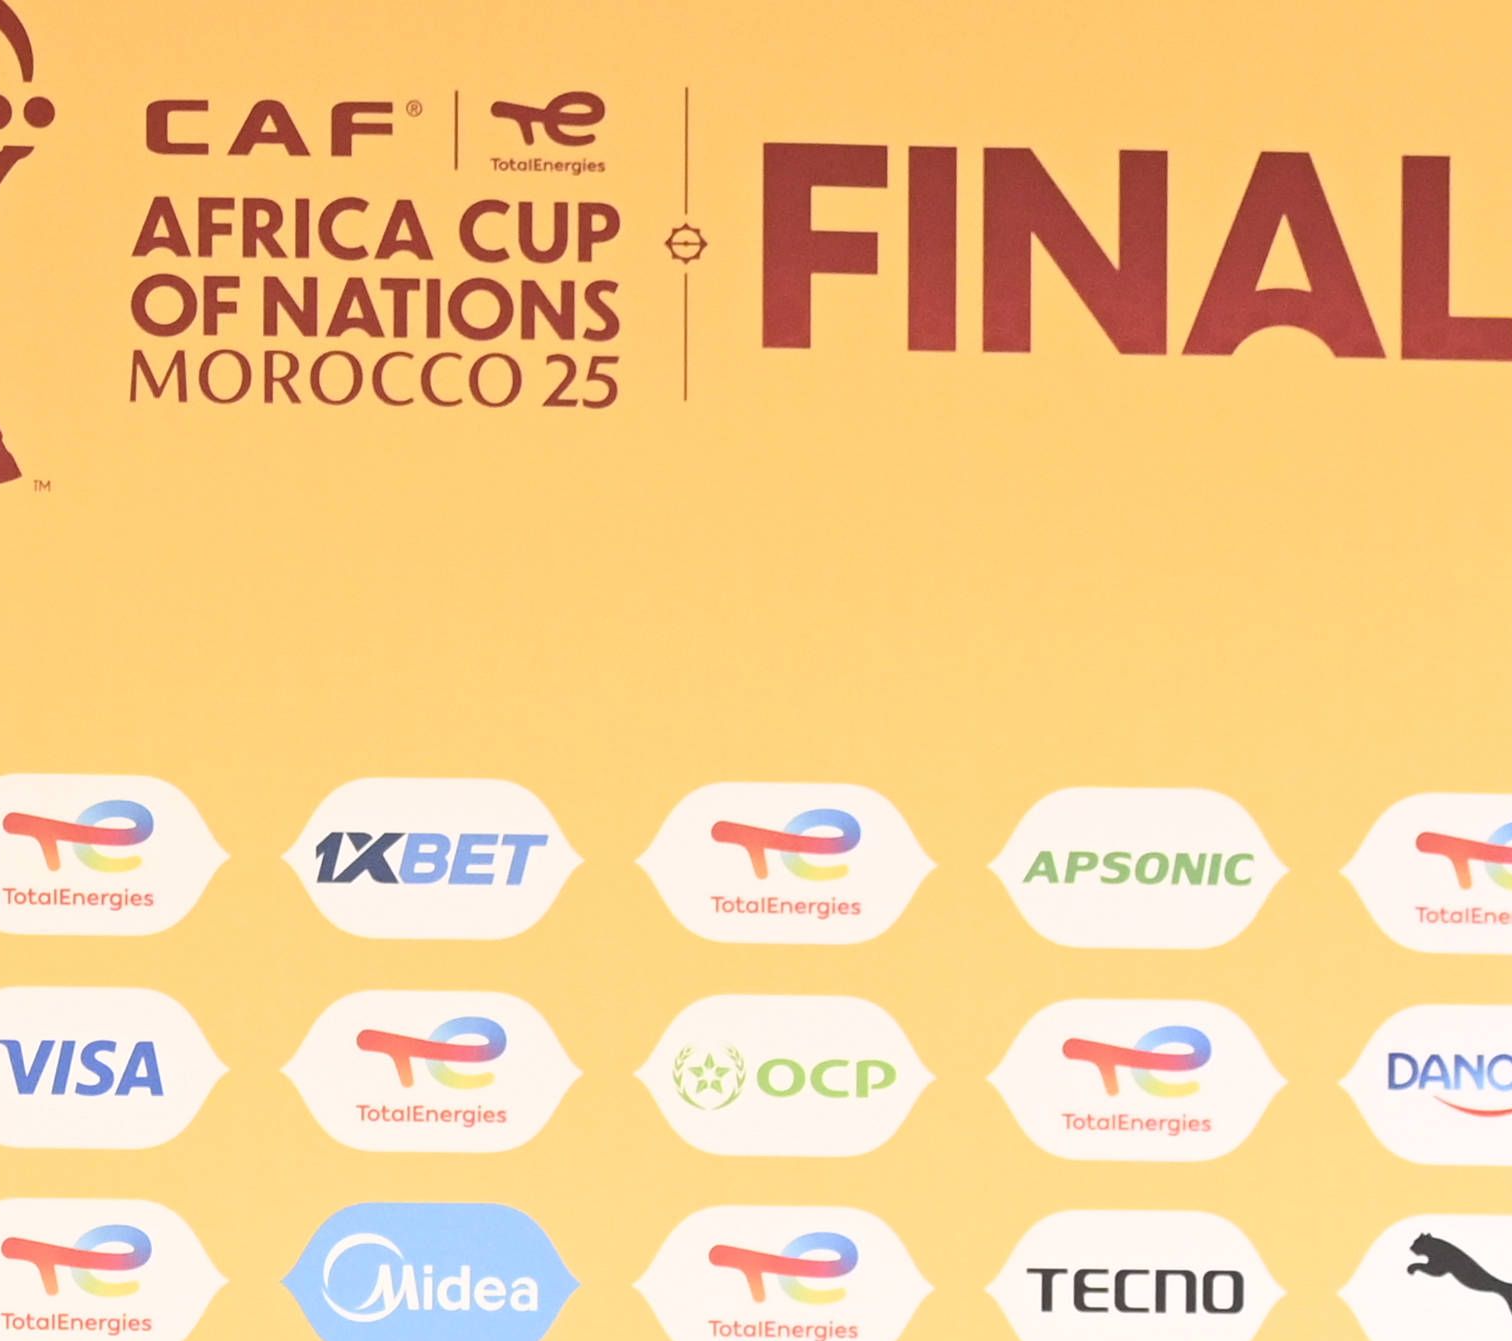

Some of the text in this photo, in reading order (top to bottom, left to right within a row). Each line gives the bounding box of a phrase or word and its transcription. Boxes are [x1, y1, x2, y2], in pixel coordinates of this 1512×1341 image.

[146, 100, 393, 156] CAF
[490, 158, 605, 176] TotalEnergies
[132, 196, 620, 263] AFRICA CUP
[131, 274, 620, 341] OF NATIONS
[130, 349, 619, 409] MOROCCO 25
[316, 832, 547, 884] 1XBET
[1023, 851, 1254, 886] APSONIC
[2, 888, 154, 911] TotalEnergies
[757, 1058, 897, 1098] OCP
[356, 1105, 507, 1128] TotalEnergies
[1062, 1113, 1211, 1136] TotalEnergies
[364, 1262, 538, 1315] Midea
[1027, 1268, 1244, 1313] TECNO
